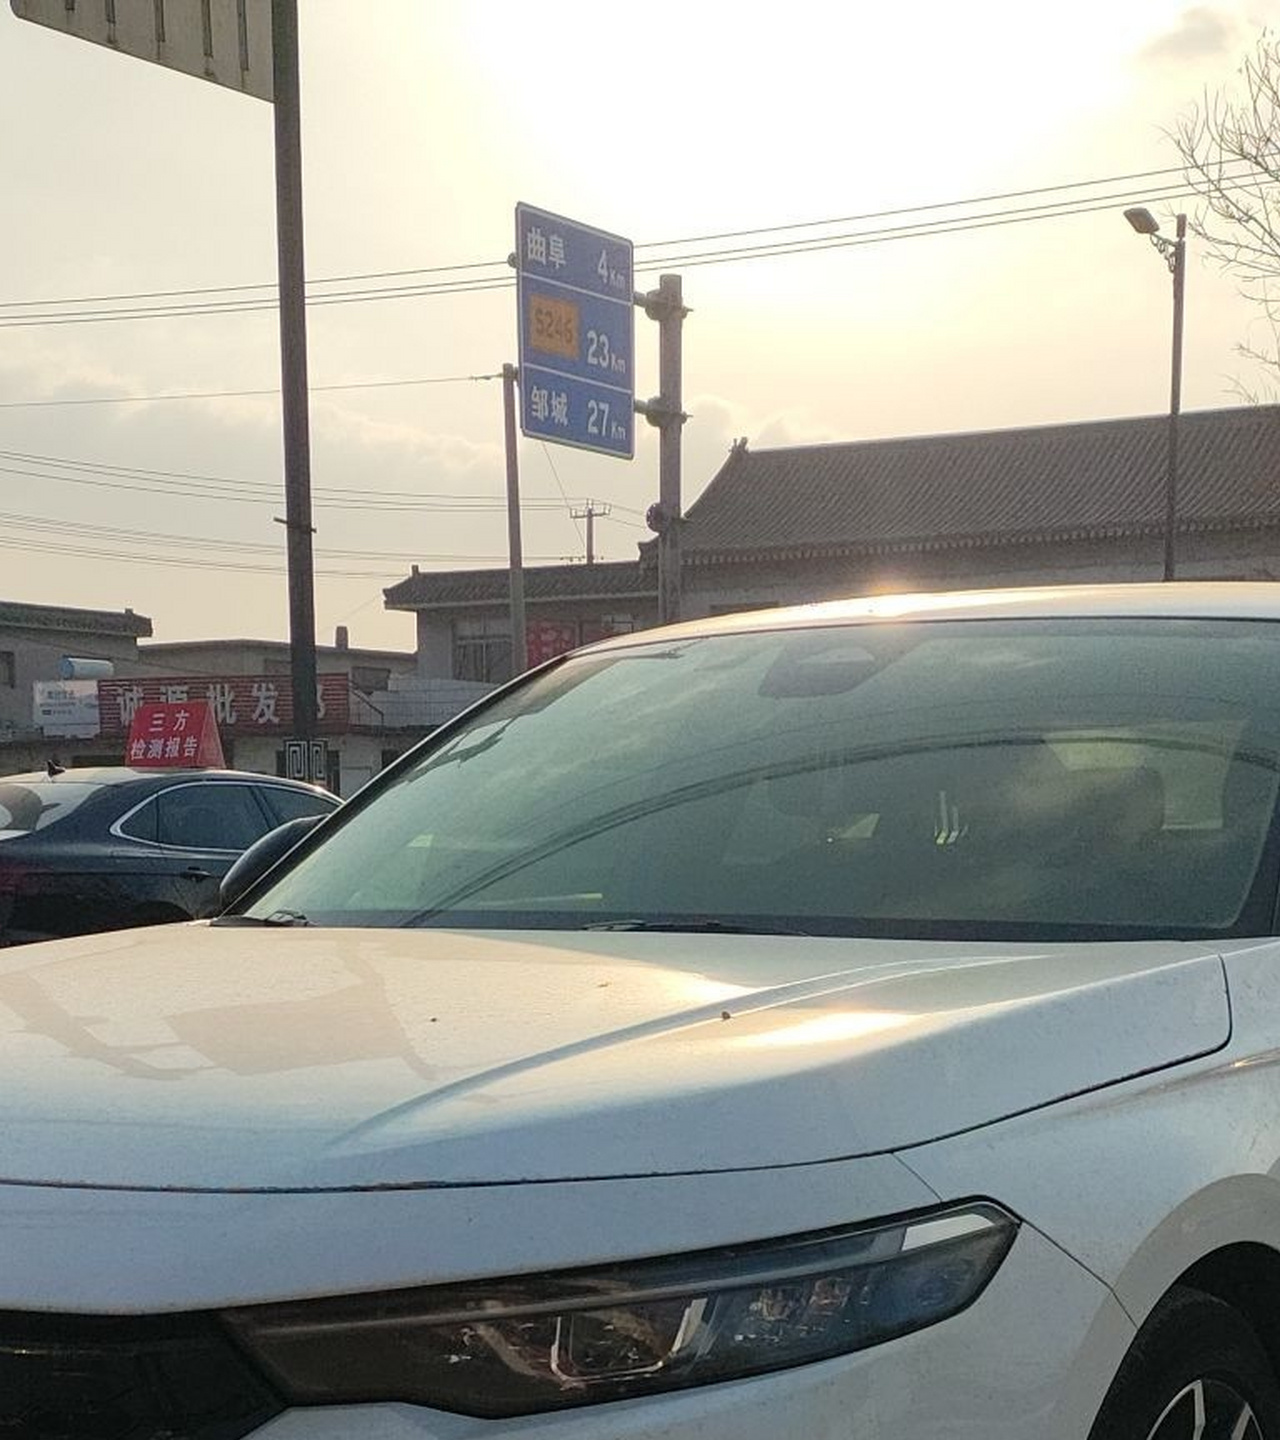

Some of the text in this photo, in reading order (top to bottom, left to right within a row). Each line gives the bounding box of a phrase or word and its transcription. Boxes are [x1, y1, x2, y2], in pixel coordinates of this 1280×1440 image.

[528, 226, 567, 270] 曲阜
[531, 385, 569, 427] 邹城
[149, 709, 191, 732] 三方
[130, 736, 199, 761] 检测报告
